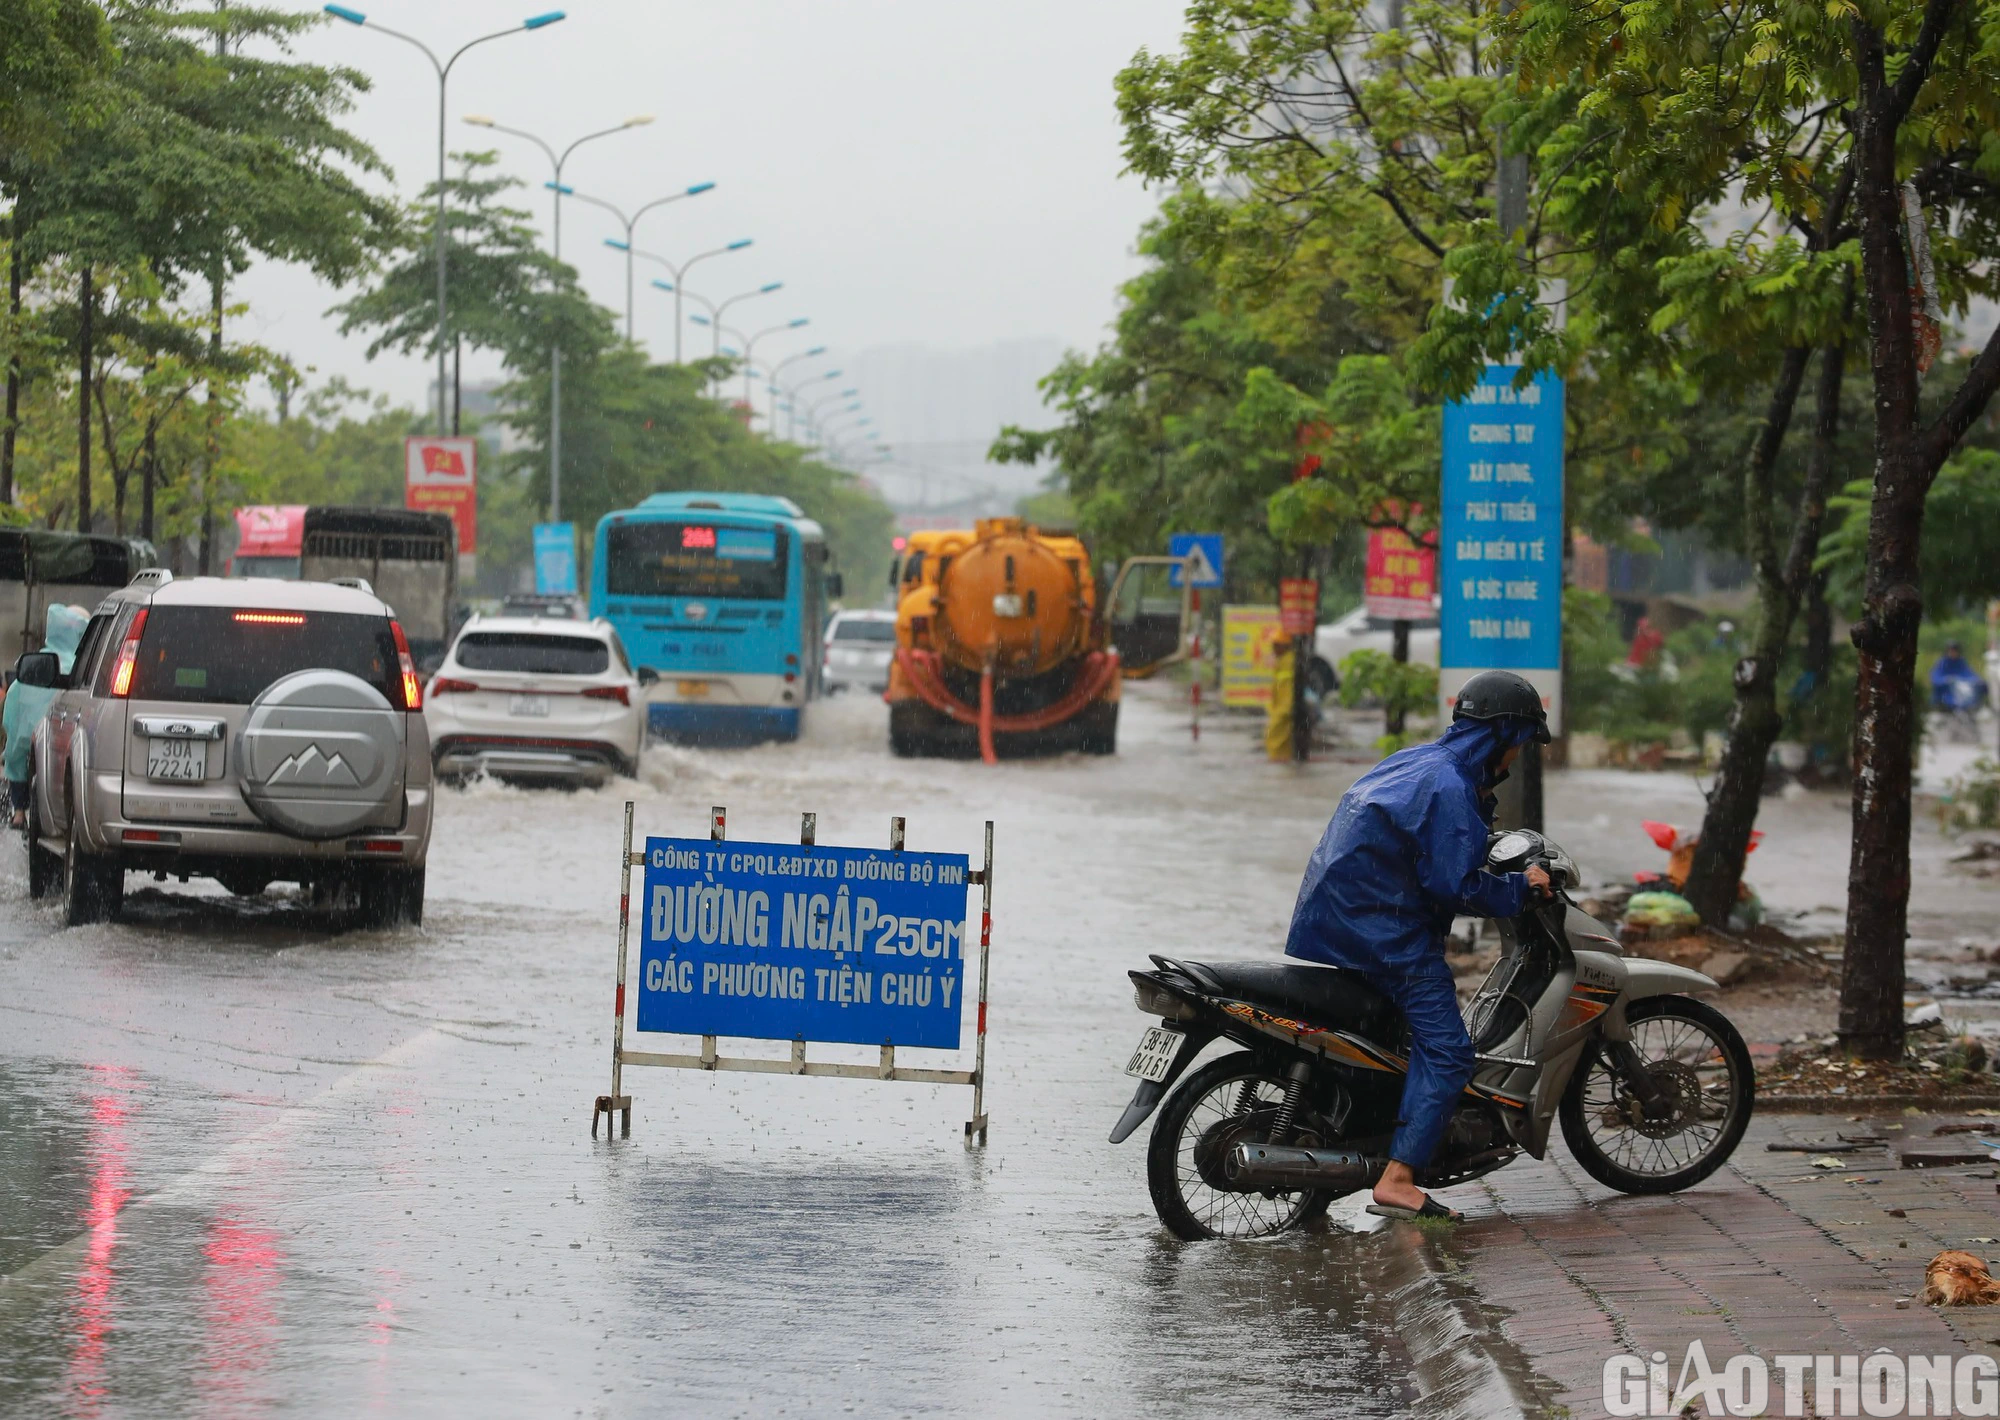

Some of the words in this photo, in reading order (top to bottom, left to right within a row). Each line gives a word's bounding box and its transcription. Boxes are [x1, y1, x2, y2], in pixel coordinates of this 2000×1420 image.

[1469, 424, 1511, 444] CHUNG
[1514, 424, 1535, 444] TAY
[1469, 460, 1493, 482] XÂY
[1466, 499, 1497, 521] PHÁT
[1501, 496, 1536, 521] TRIỂN
[1456, 535, 1482, 561] BẢO
[1484, 534, 1516, 561] HIỂM
[1519, 541, 1528, 560] Y
[1529, 537, 1545, 561] TẾ
[1462, 576, 1475, 600] VÌ
[1477, 576, 1502, 600] SỨC
[1469, 615, 1501, 639] TOÀN
[1504, 616, 1531, 639] DÂN
[163, 740, 192, 759] 30A
[150, 759, 202, 779] 722.41
[652, 845, 700, 870] CÔNG
[706, 852, 727, 871] TY
[731, 853, 838, 878] CPQL&ĐTXD
[844, 853, 905, 881] ĐƯỜNG
[910, 860, 933, 886] BỘ
[938, 865, 963, 885] HN
[651, 872, 769, 947] ĐƯỜNG
[781, 884, 878, 960] NGẬP
[875, 914, 966, 960] 25CM
[645, 953, 694, 993] CÁC
[702, 962, 805, 1000] PHƯƠNG
[815, 964, 872, 1008] TIỆN
[881, 967, 932, 1007] CHÚ
[940, 967, 955, 1008] Ý
[1144, 1031, 1178, 1056] 38-H1
[1129, 1052, 1169, 1078] 041.61
